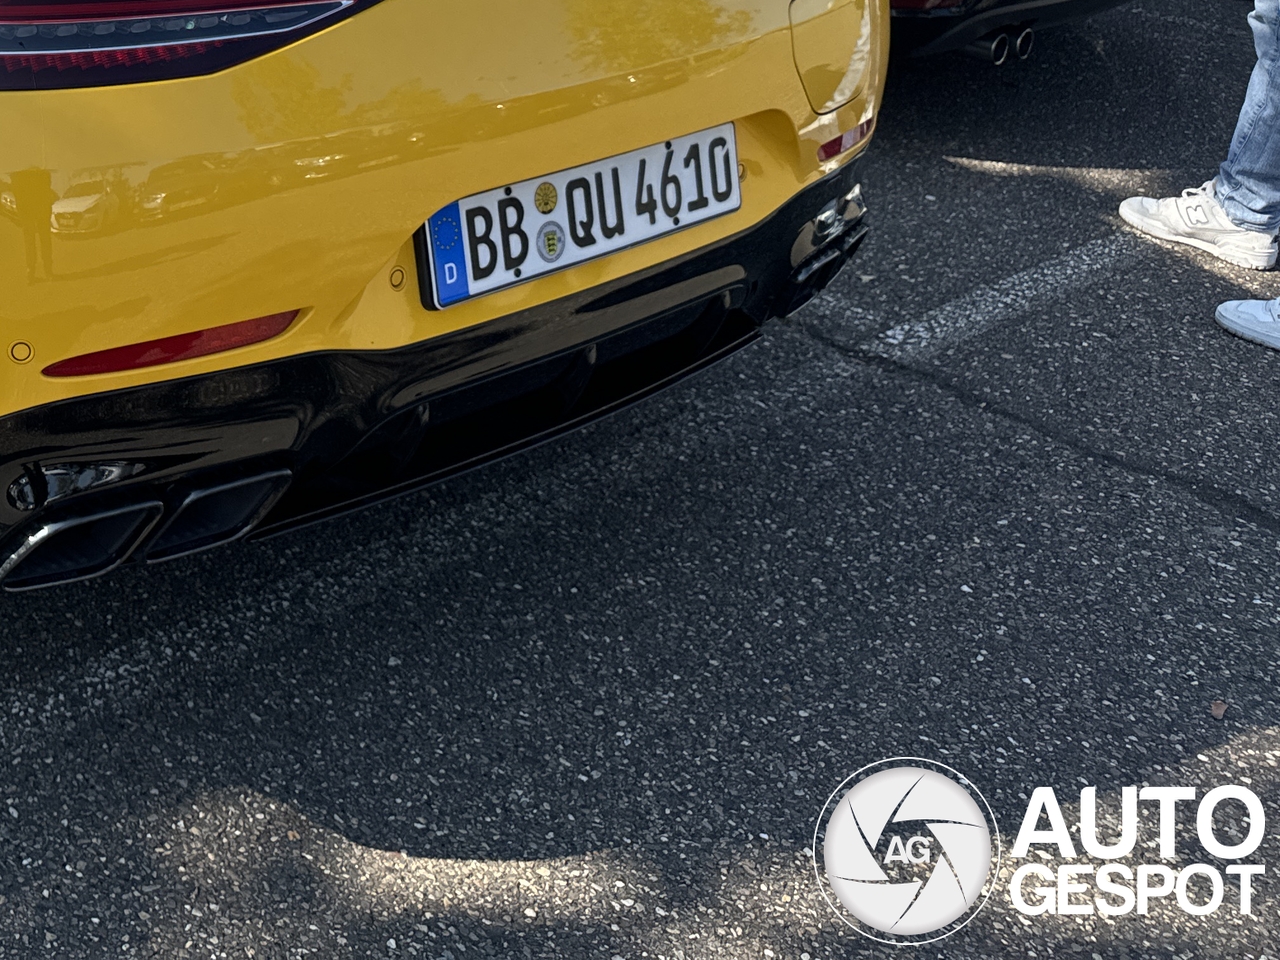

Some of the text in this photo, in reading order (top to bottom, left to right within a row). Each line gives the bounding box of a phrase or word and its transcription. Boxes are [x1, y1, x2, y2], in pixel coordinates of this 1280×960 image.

[465, 135, 733, 282] BB QU 4610
[444, 262, 458, 285] D
